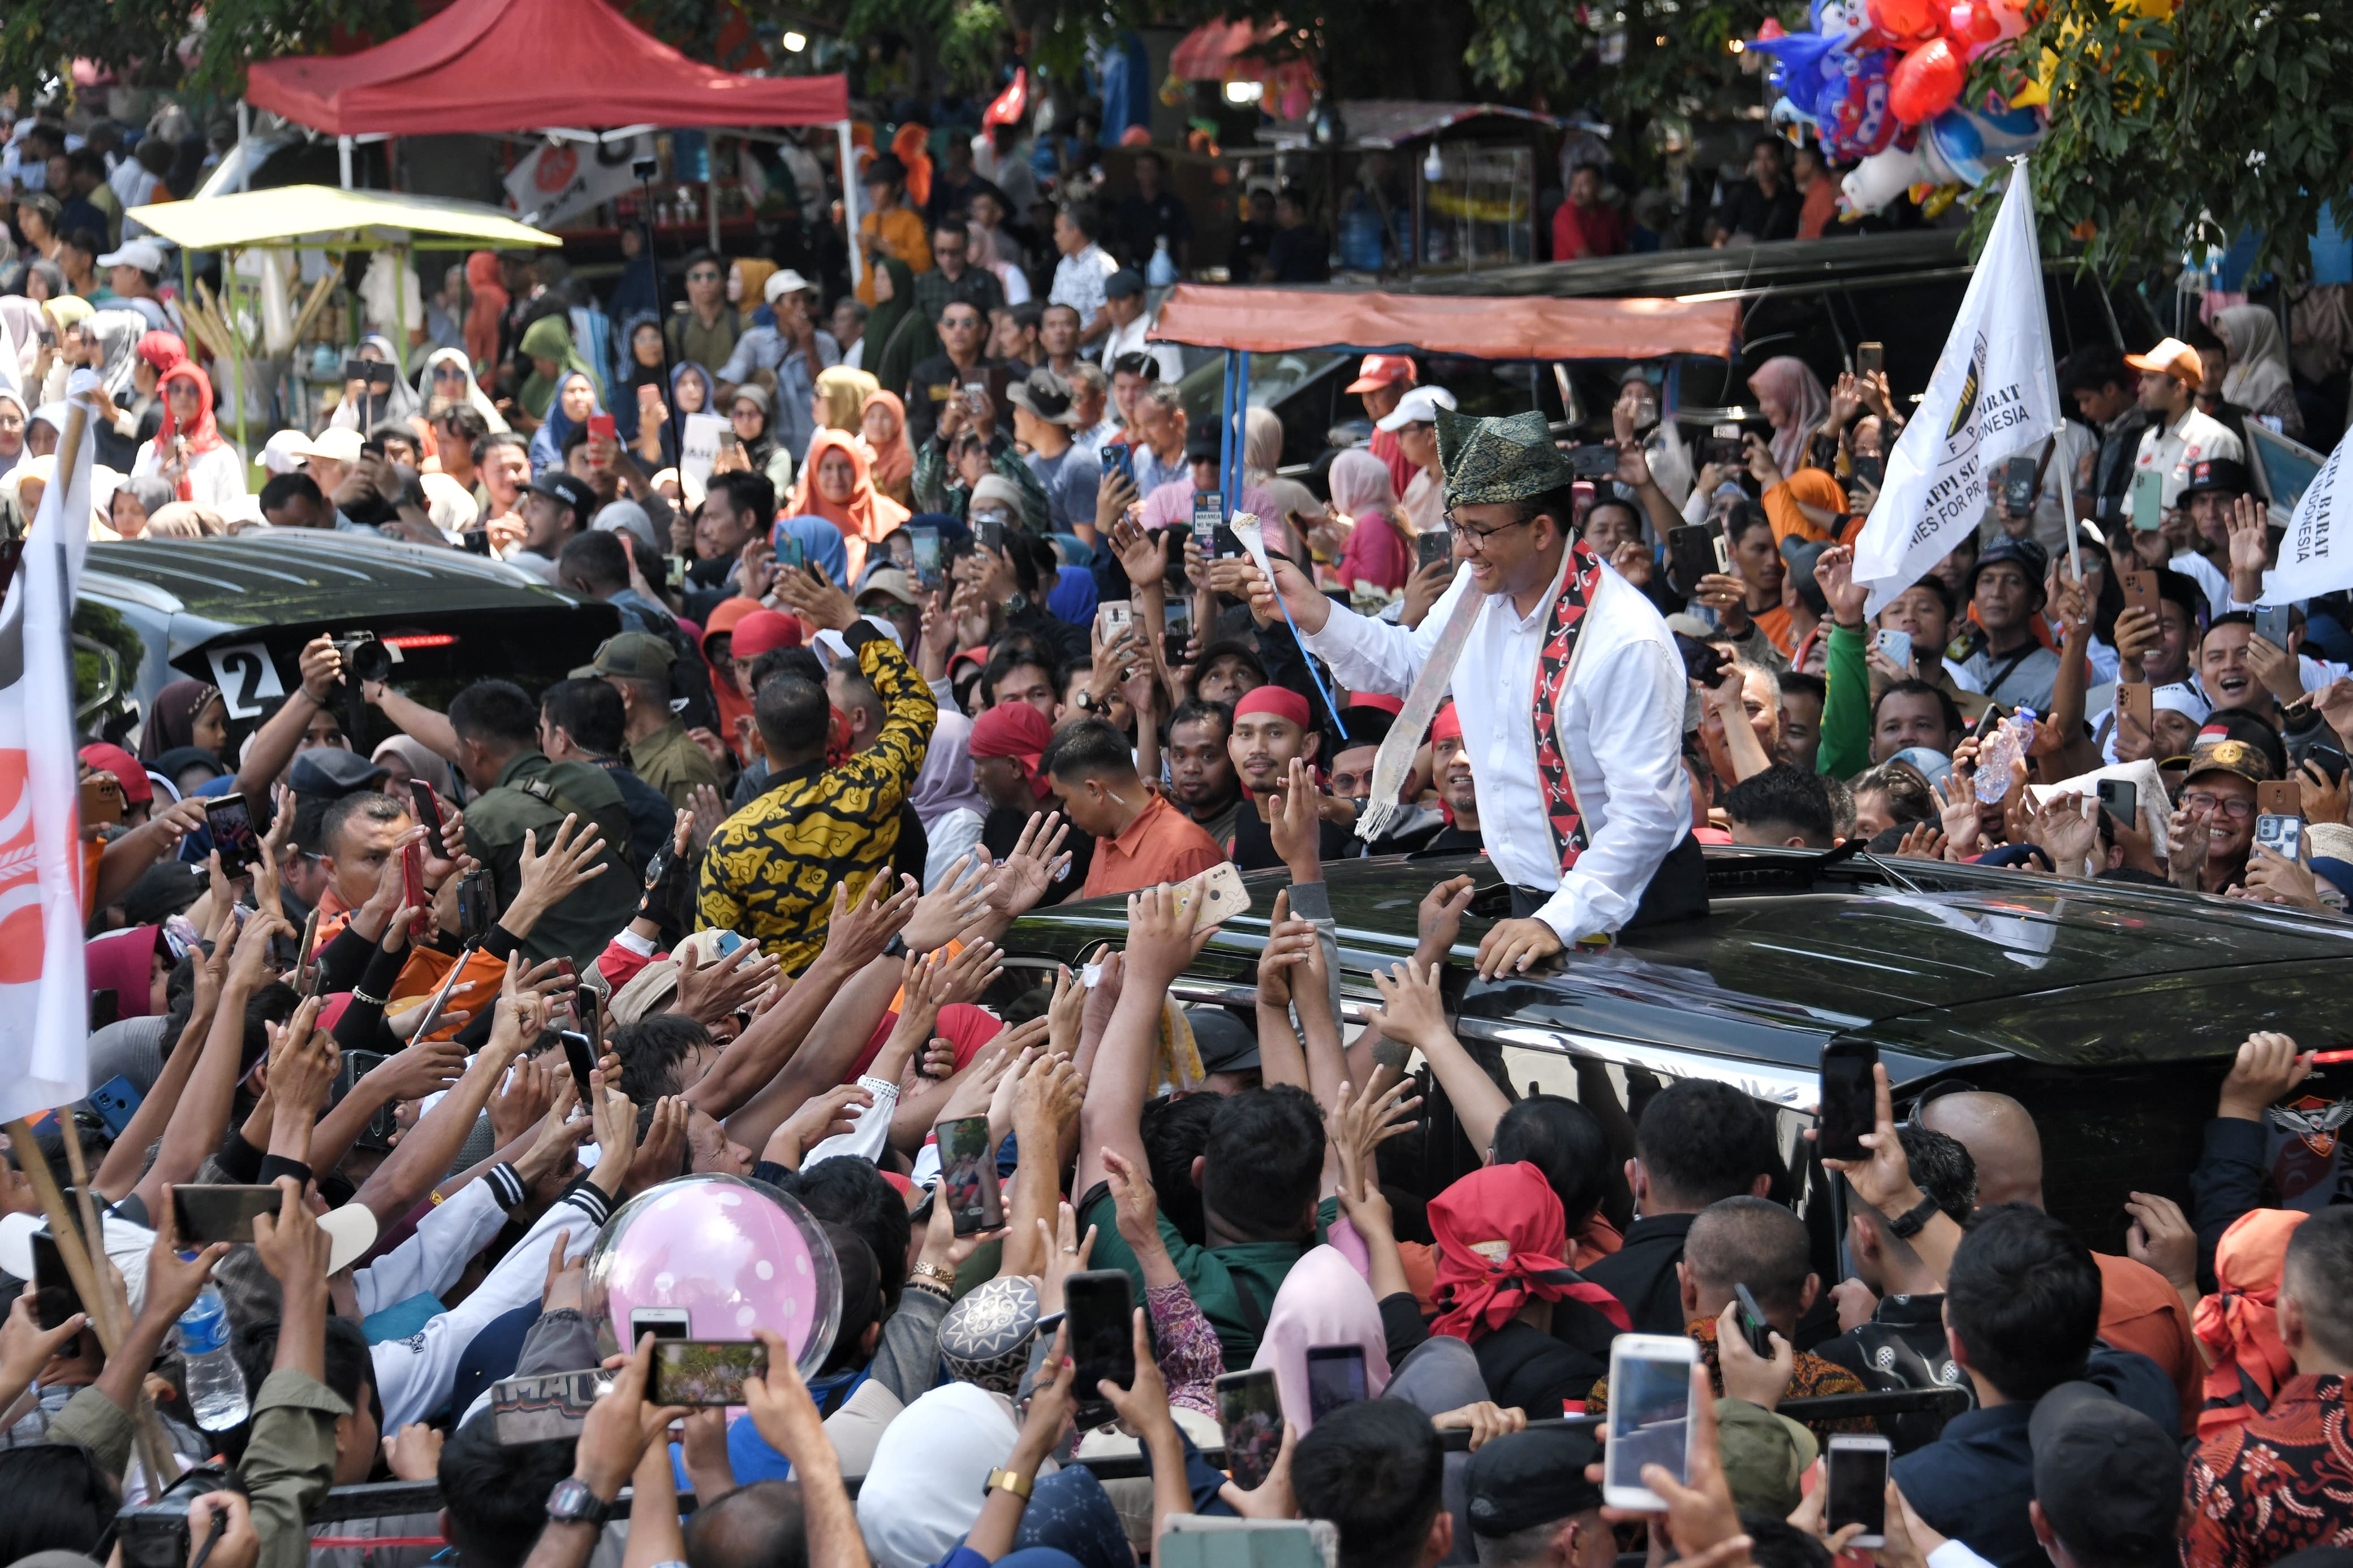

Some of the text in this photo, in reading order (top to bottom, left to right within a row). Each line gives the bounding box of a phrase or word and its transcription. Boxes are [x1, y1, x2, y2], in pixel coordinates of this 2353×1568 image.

[1937, 494, 1967, 524] FOR
[2315, 495, 2333, 558] BARAT
[222, 652, 269, 710] 2
